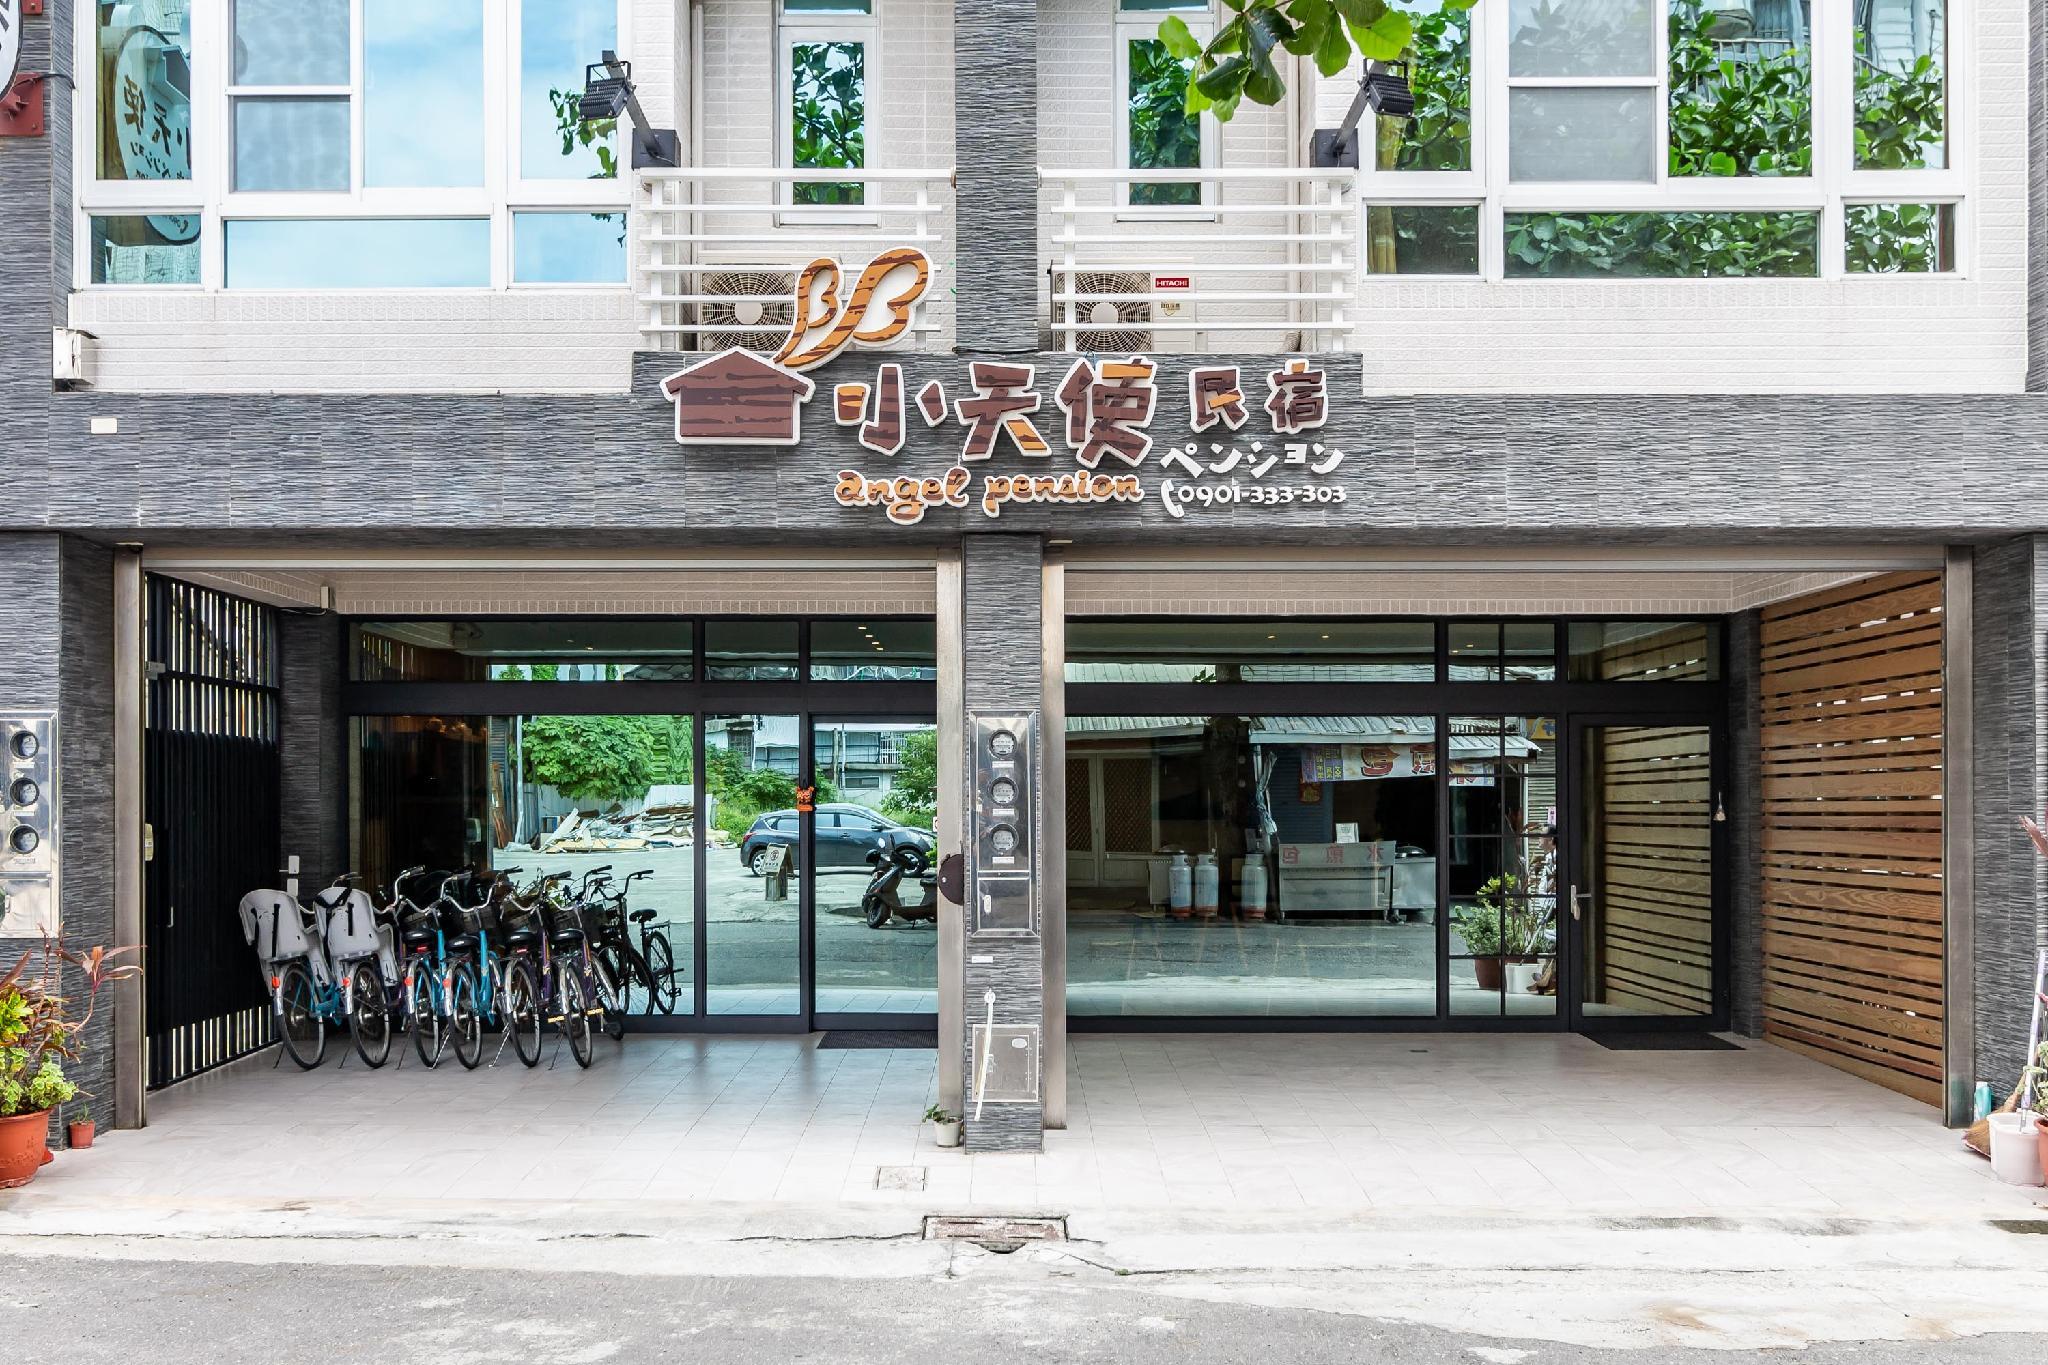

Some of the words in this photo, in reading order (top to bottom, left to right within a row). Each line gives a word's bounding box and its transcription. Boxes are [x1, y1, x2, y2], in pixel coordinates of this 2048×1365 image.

[1156, 279, 1188, 287] HITACHI
[834, 358, 1157, 469] 小天使
[1189, 359, 1328, 434] 民宿
[1160, 441, 1345, 478] ペンション
[834, 466, 971, 525] angel
[982, 469, 1145, 517] pension
[1177, 484, 1347, 507] 0901-333-303
